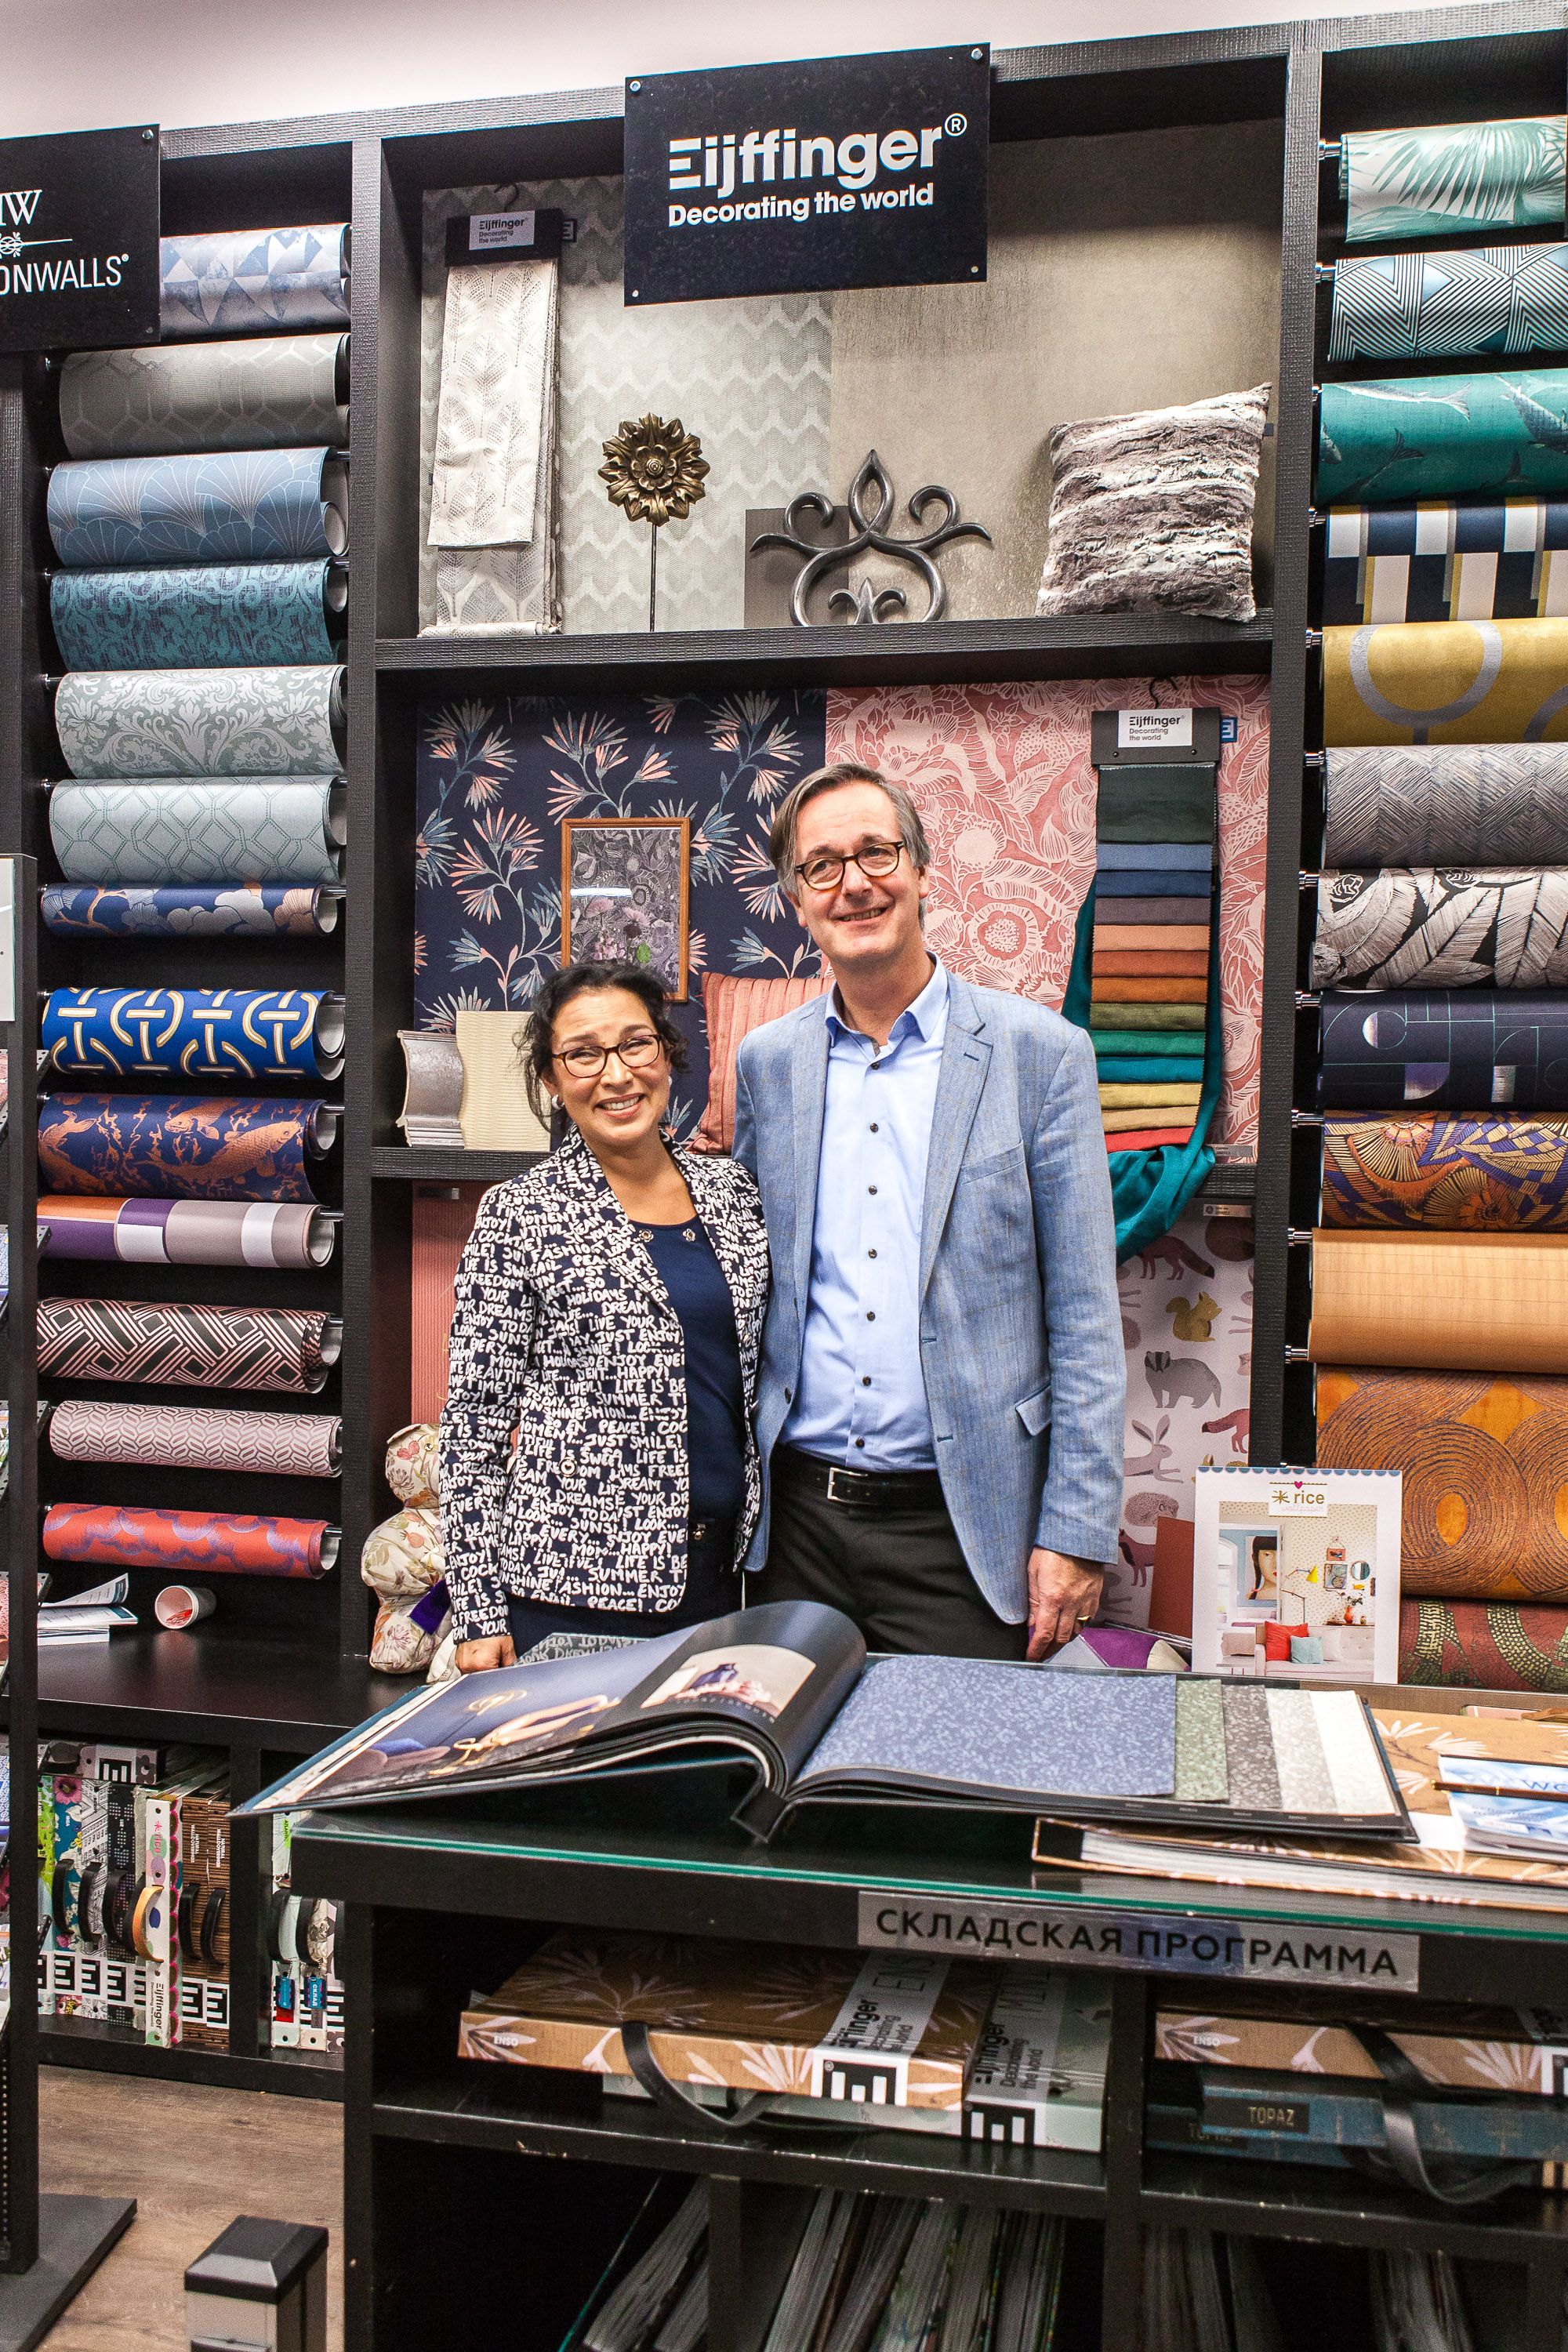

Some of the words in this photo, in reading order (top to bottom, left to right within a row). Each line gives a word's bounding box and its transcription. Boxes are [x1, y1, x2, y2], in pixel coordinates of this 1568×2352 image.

[0, 189, 43, 227] W
[668, 195, 810, 227] Decorating
[814, 191, 856, 215] the
[860, 182, 934, 211] world
[601, 1301, 649, 1316] DREAM
[615, 1379, 647, 1393] LIFE
[652, 1378, 664, 1393] IS
[596, 1392, 662, 1408] SUMMER
[630, 1433, 682, 1450] SMILE!
[637, 1450, 667, 1465] LIFE
[673, 1447, 688, 1463] IS
[631, 1491, 666, 1507] YOUR
[1294, 1490, 1325, 1504] rice
[621, 1543, 672, 1559] HAPPY!
[615, 1555, 648, 1569] LIFE
[653, 1555, 666, 1570] IS
[588, 1569, 663, 1584] SUMMER
[876, 1908, 1122, 1953] СКЛАДСКАЯ
[1137, 1930, 1398, 1976] ПРОГРАММА
[494, 2035, 519, 2048] ENSO
[1247, 2106, 1295, 2127] TOPAZ
